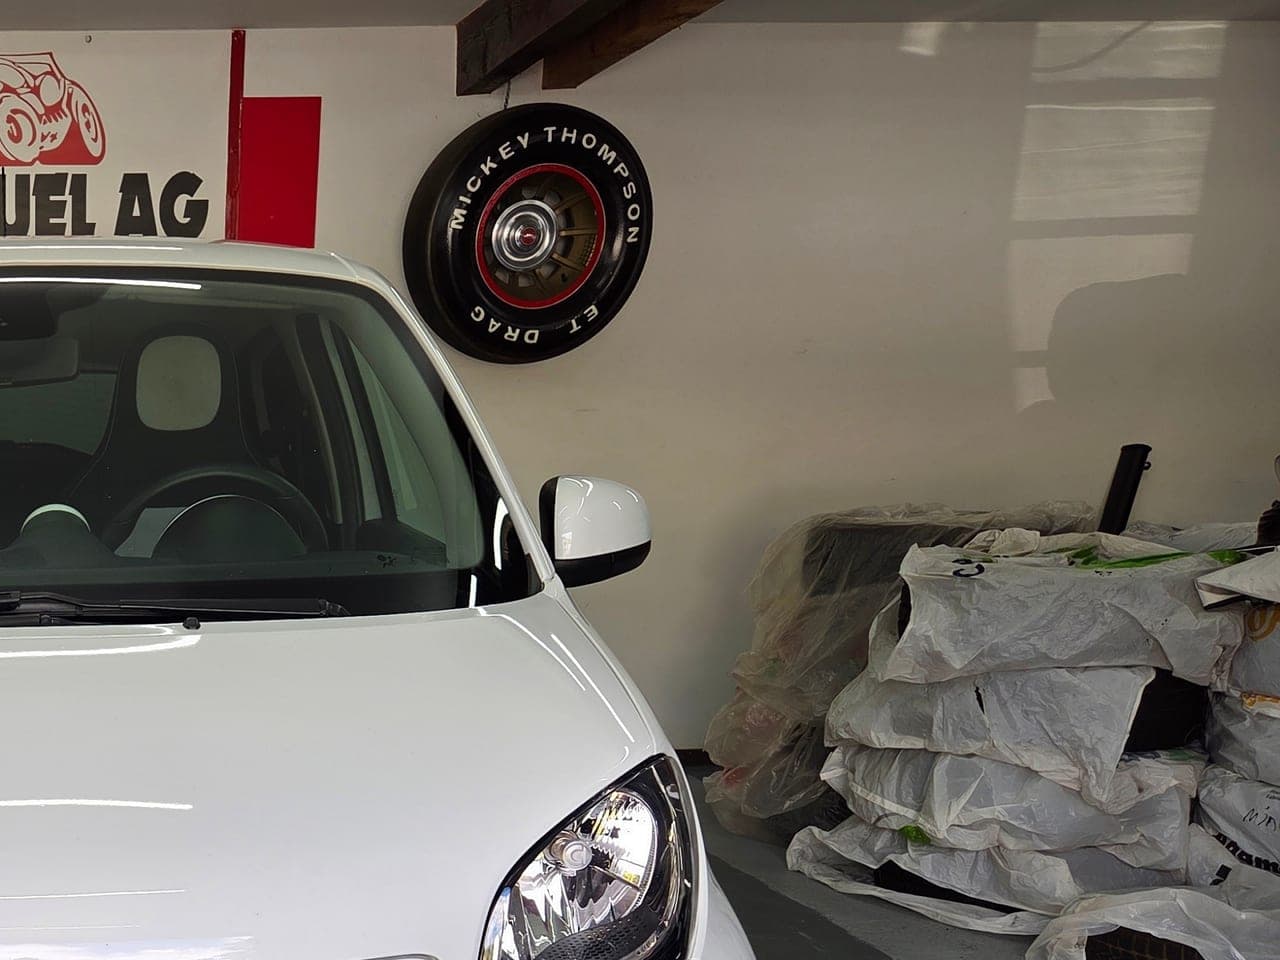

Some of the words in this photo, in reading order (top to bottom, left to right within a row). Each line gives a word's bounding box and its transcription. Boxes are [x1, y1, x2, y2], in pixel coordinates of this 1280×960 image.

[113, 171, 209, 238] AG
[451, 132, 529, 230] MICKEY
[543, 126, 640, 243] THOMPSON
[470, 305, 540, 344] DRAG
